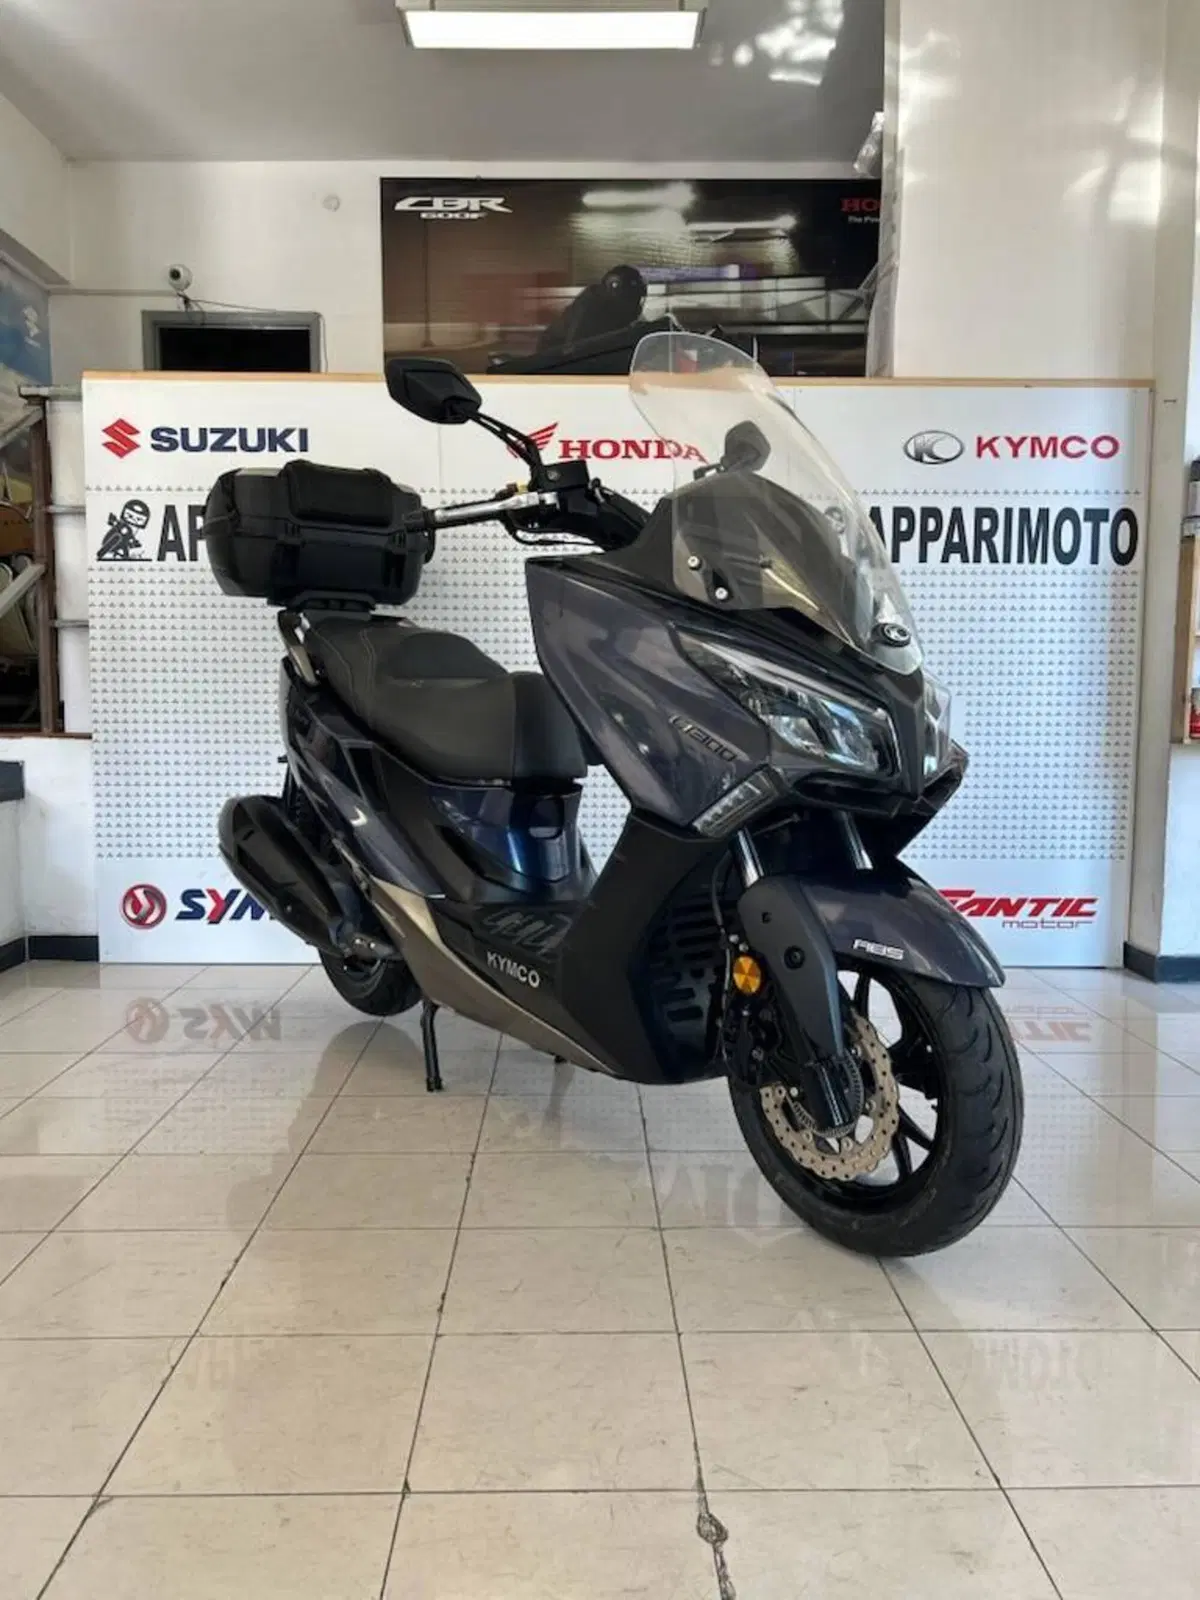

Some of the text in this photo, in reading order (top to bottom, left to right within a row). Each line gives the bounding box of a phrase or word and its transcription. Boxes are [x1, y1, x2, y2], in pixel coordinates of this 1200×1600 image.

[394, 196, 513, 214] CBR
[150, 426, 309, 452] SUZUKI
[558, 438, 709, 465] HONDA
[975, 434, 1121, 459] KYMCO
[1001, 918, 1093, 929] motor
[852, 938, 904, 960] ABS
[486, 951, 540, 988] KYMCO
